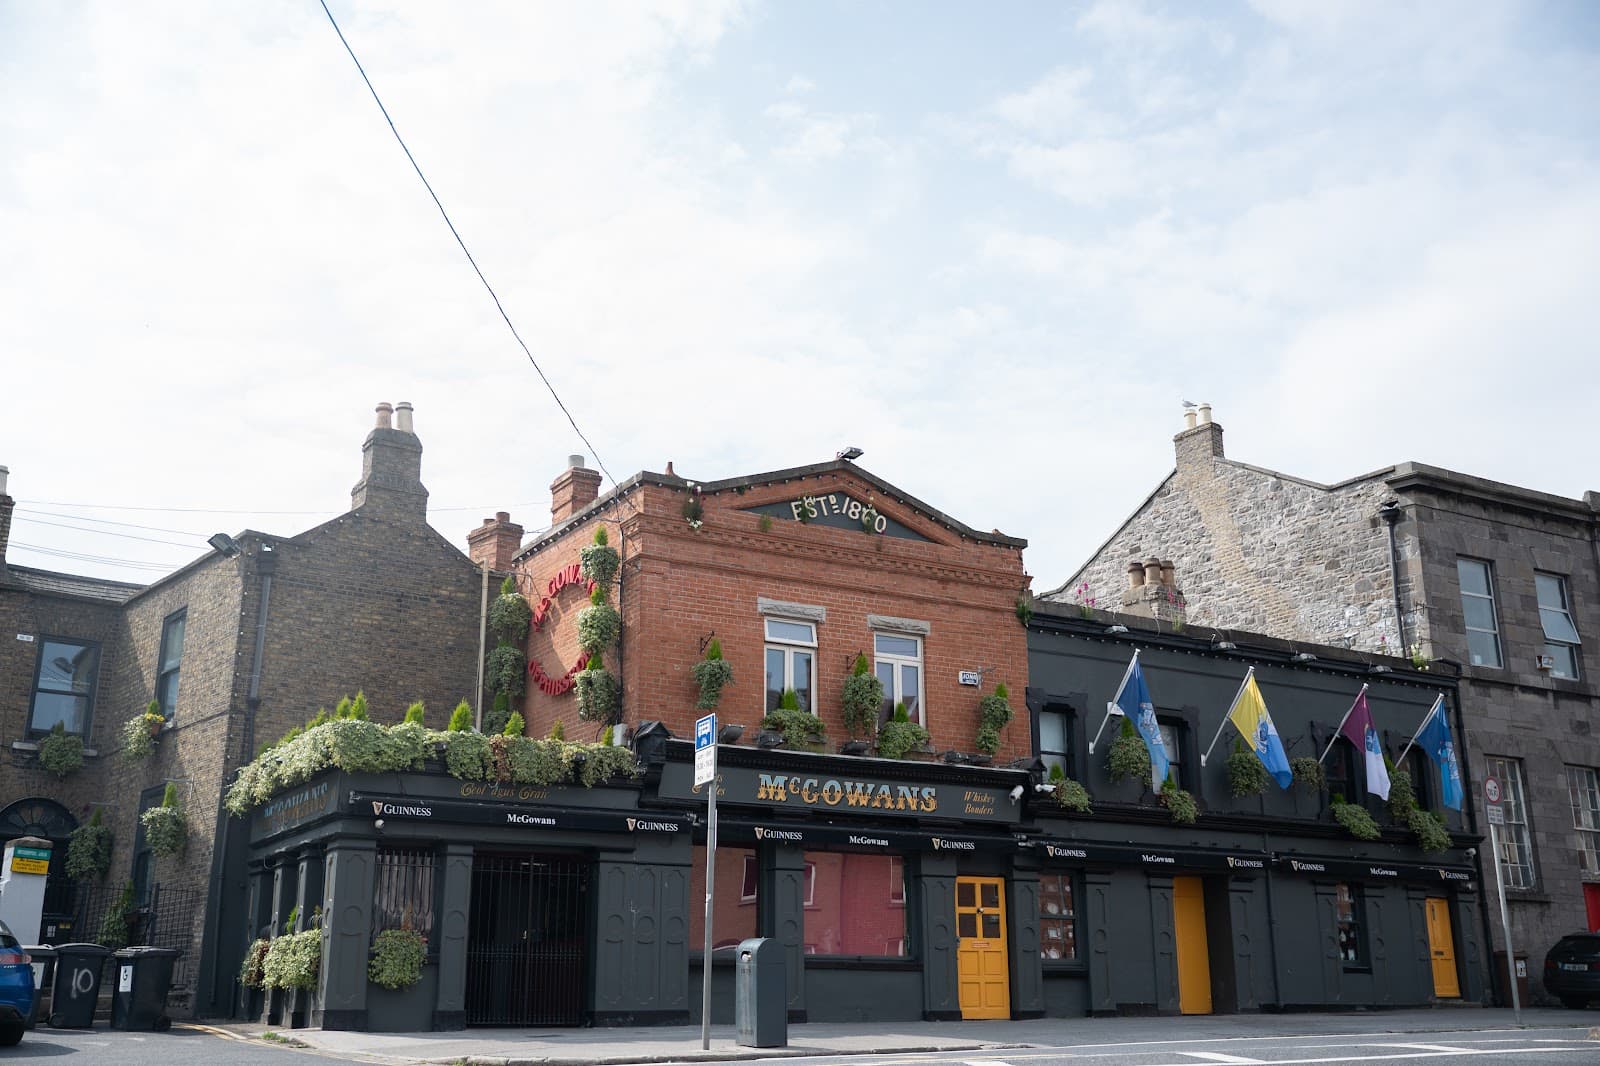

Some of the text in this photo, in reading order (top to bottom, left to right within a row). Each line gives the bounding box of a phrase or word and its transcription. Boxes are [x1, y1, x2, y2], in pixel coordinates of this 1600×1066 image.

[383, 803, 432, 817] GUINNESS
[506, 813, 556, 825] McGowans
[636, 820, 679, 832] GUINNESS
[763, 829, 803, 841] GUINNESS
[849, 835, 889, 847] McGowans
[940, 839, 975, 850] GUINNESS
[1054, 847, 1087, 858] GUINNESS
[1234, 859, 1264, 868] GUINNESS
[71, 967, 94, 999] 10
